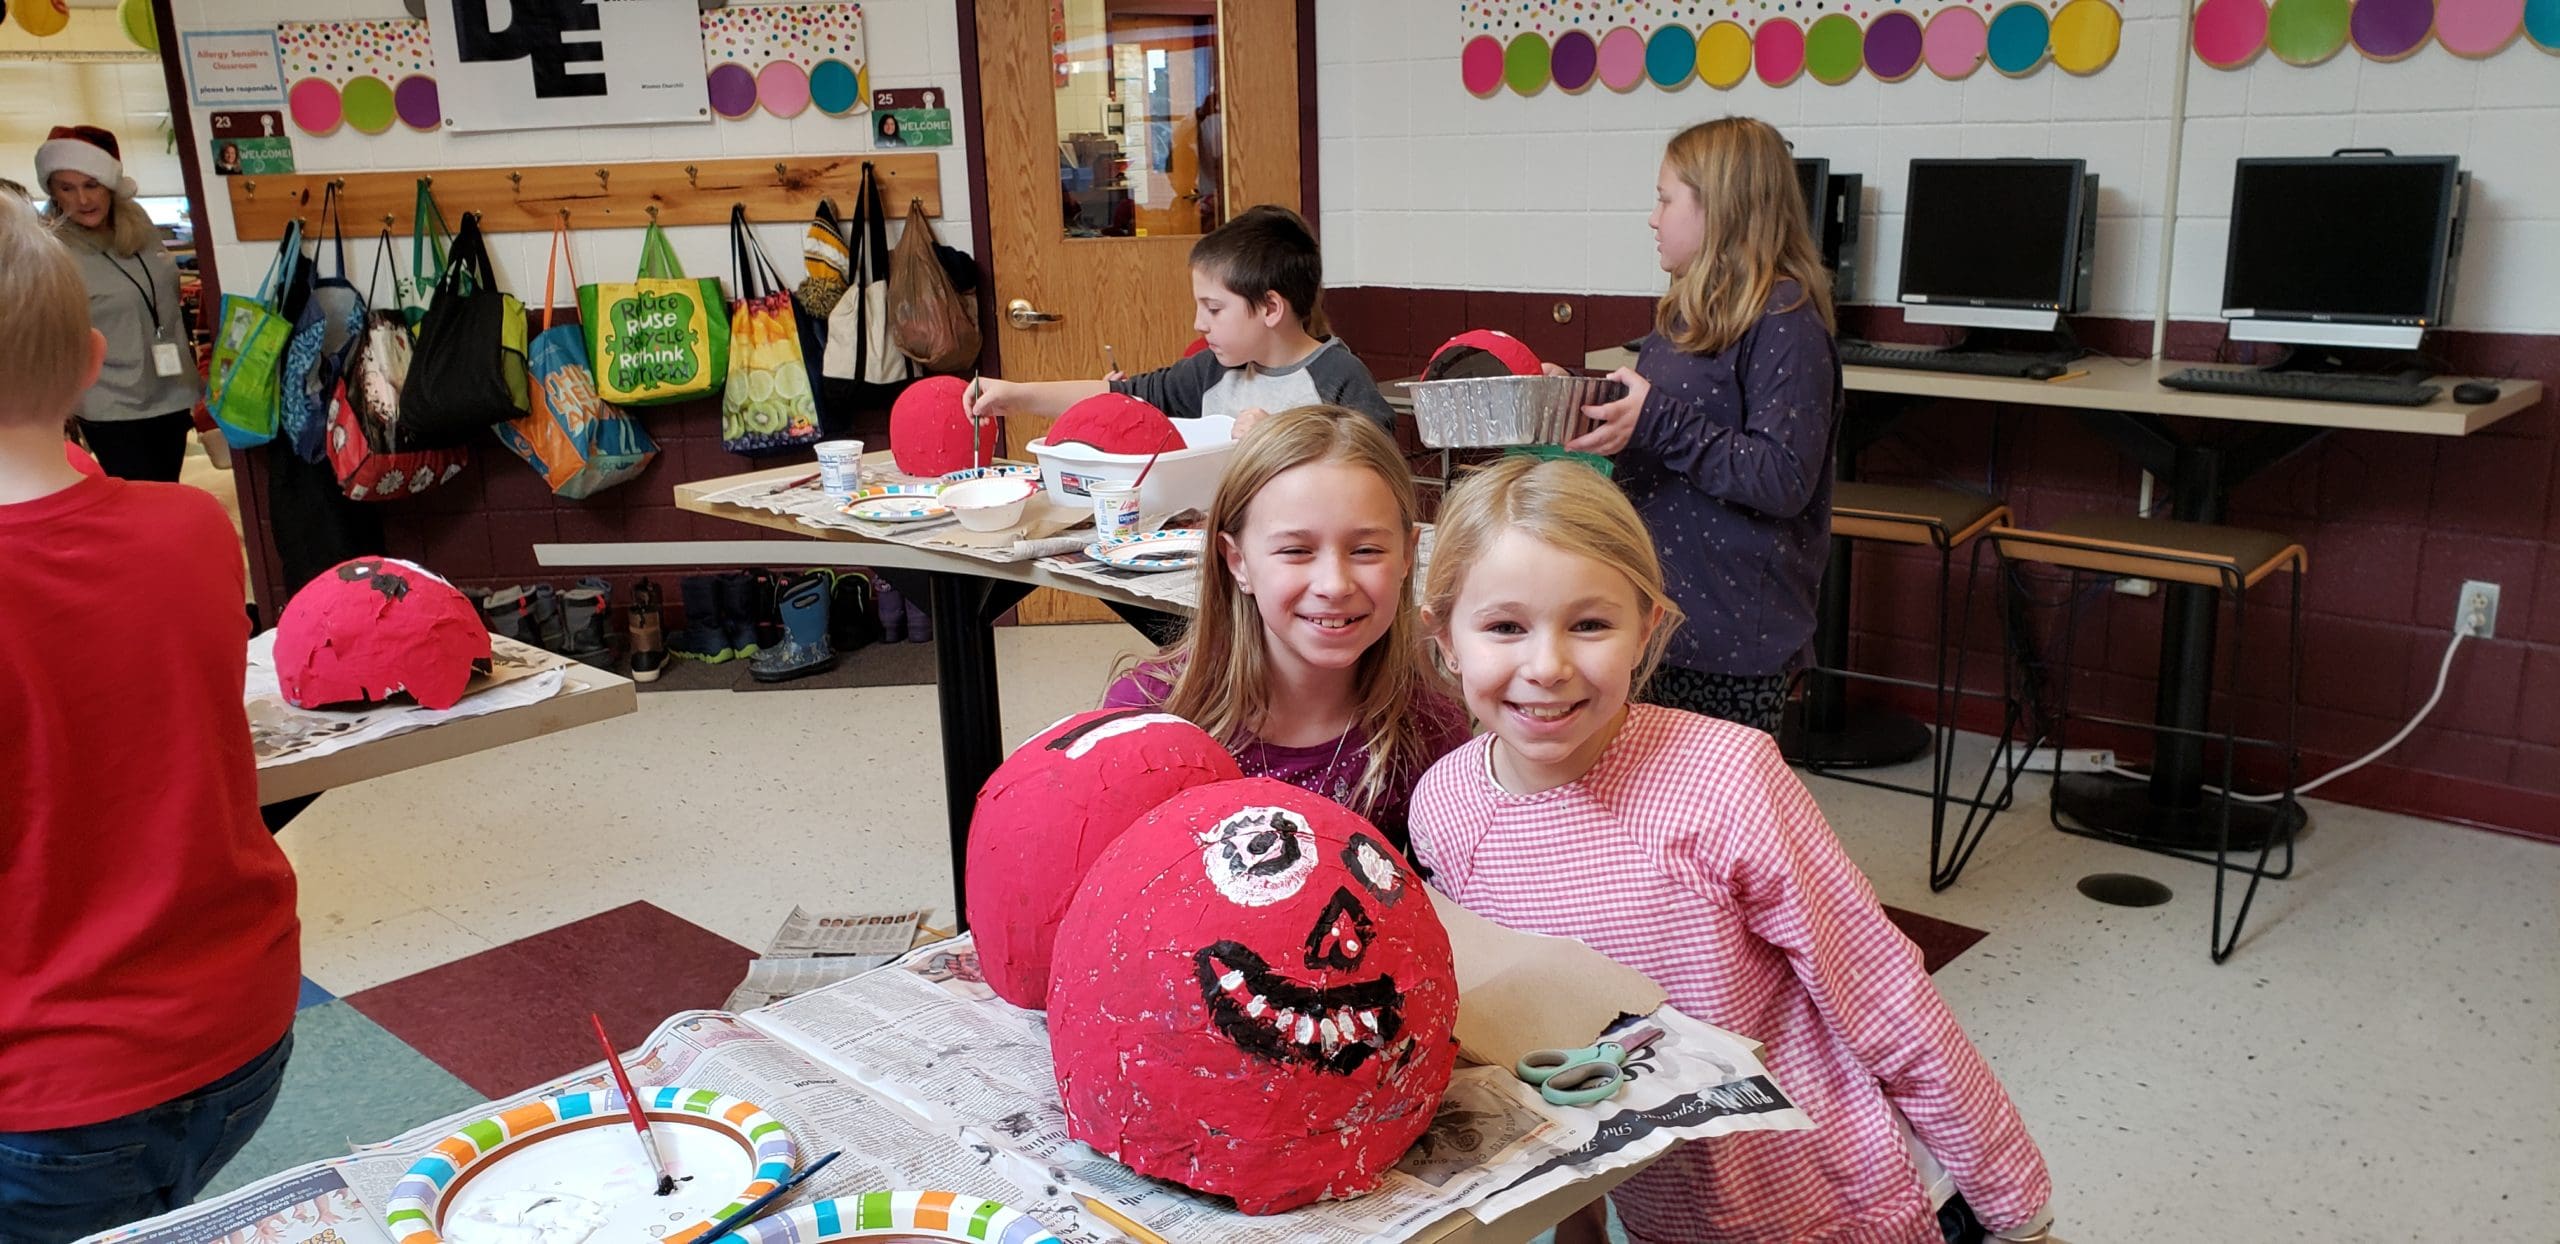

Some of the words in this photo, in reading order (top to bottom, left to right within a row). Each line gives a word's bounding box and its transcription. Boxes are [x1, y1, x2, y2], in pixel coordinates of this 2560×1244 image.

[197, 50, 229, 59] Allergy
[231, 50, 269, 58] Sensitive
[212, 62, 258, 70] Classroom
[200, 85, 224, 94] please
[236, 84, 278, 93] responsible
[878, 93, 894, 105] 25
[215, 116, 231, 128] 23
[899, 120, 951, 131] WELCOME!
[240, 149, 292, 159] WELCOME!
[1602, 1122, 1633, 1140] The
[1412, 1158, 1448, 1167] GUARD
